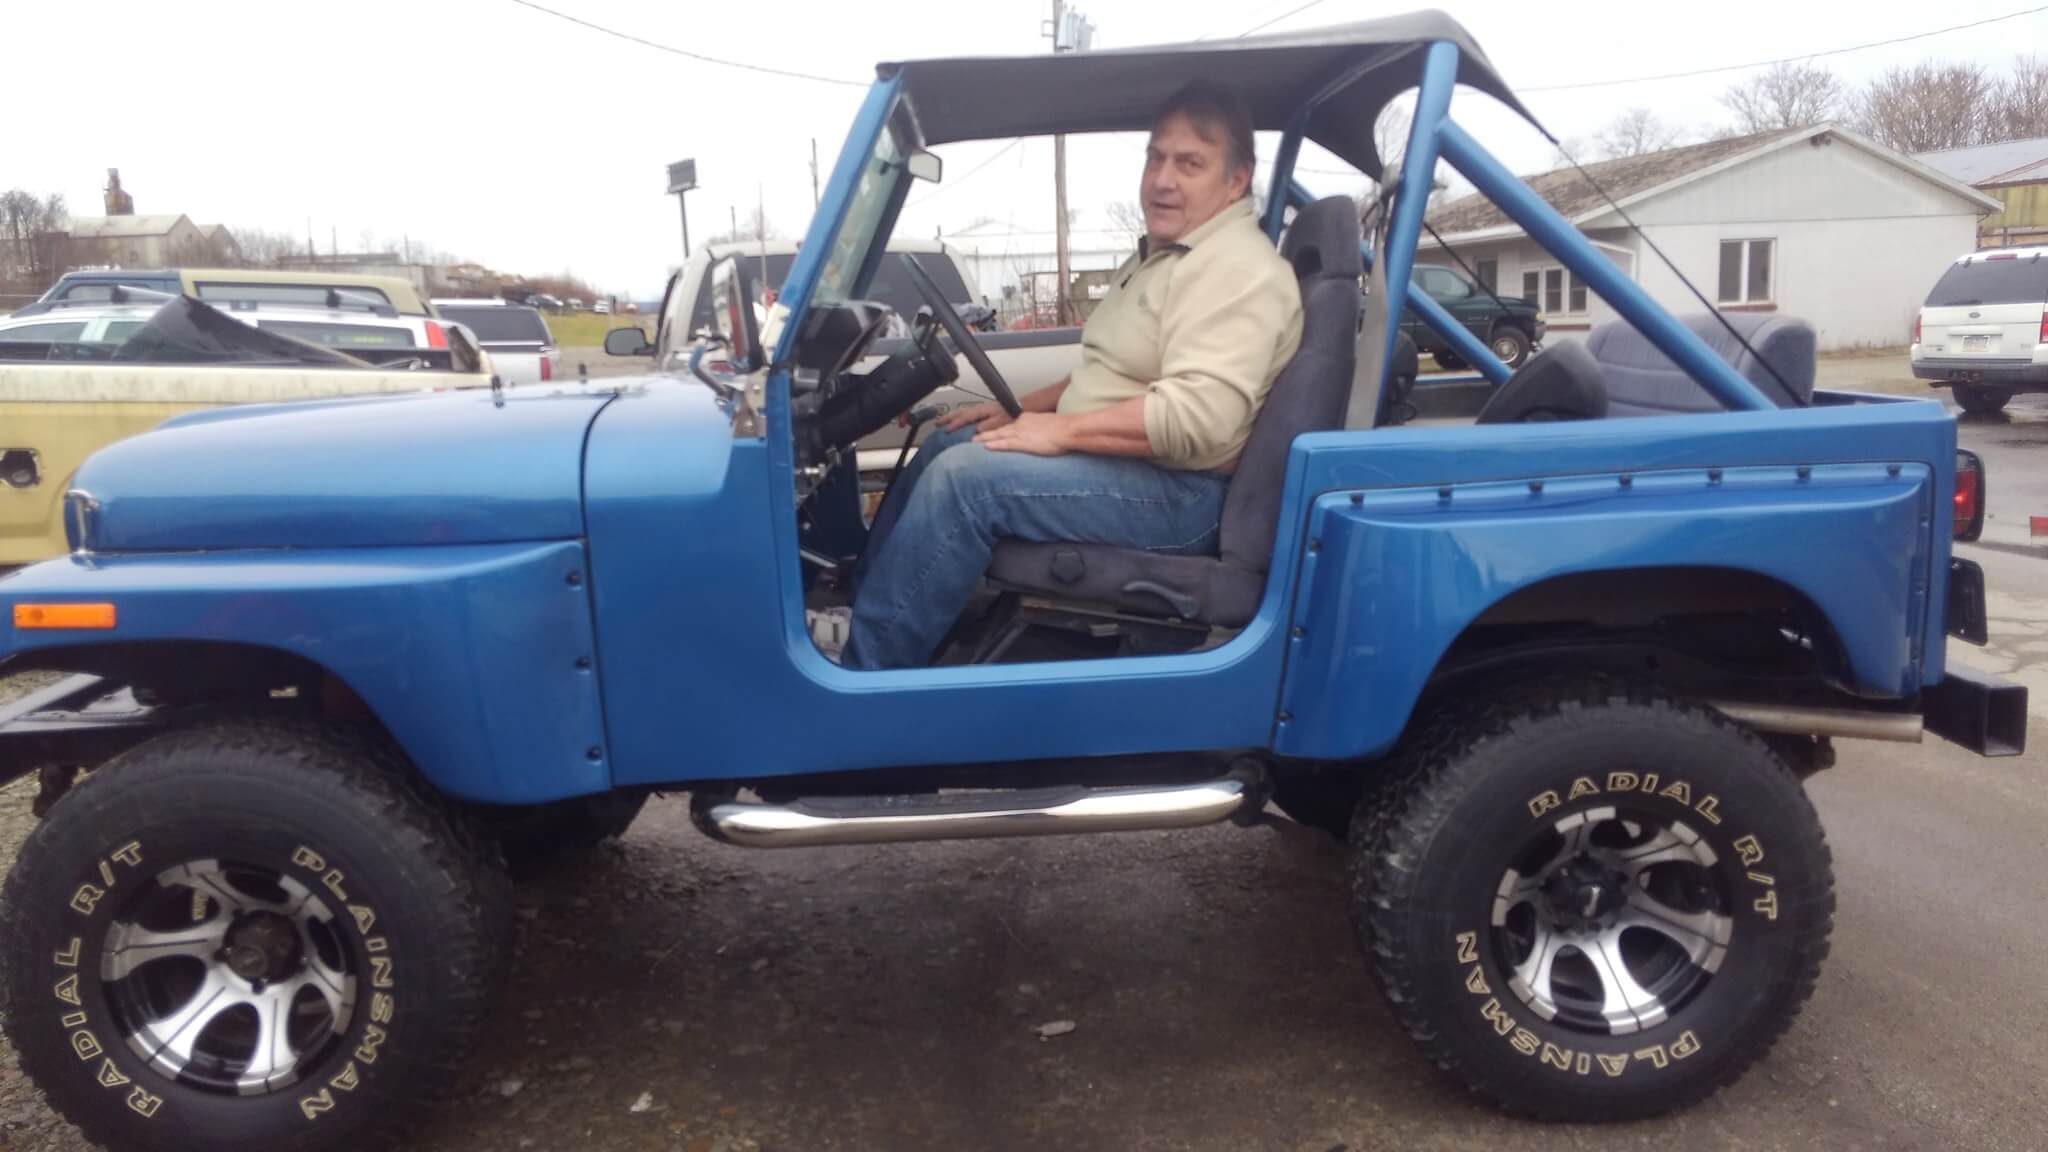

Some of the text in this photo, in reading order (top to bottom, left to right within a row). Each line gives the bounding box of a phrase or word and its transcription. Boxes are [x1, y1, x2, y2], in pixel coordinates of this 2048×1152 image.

[1527, 772, 1779, 921] RADIAL R/T
[54, 840, 163, 1118] RADIAL R/T
[292, 845, 395, 1120] PLAINSMAN
[1456, 931, 1702, 1077] PLAINSMAN
